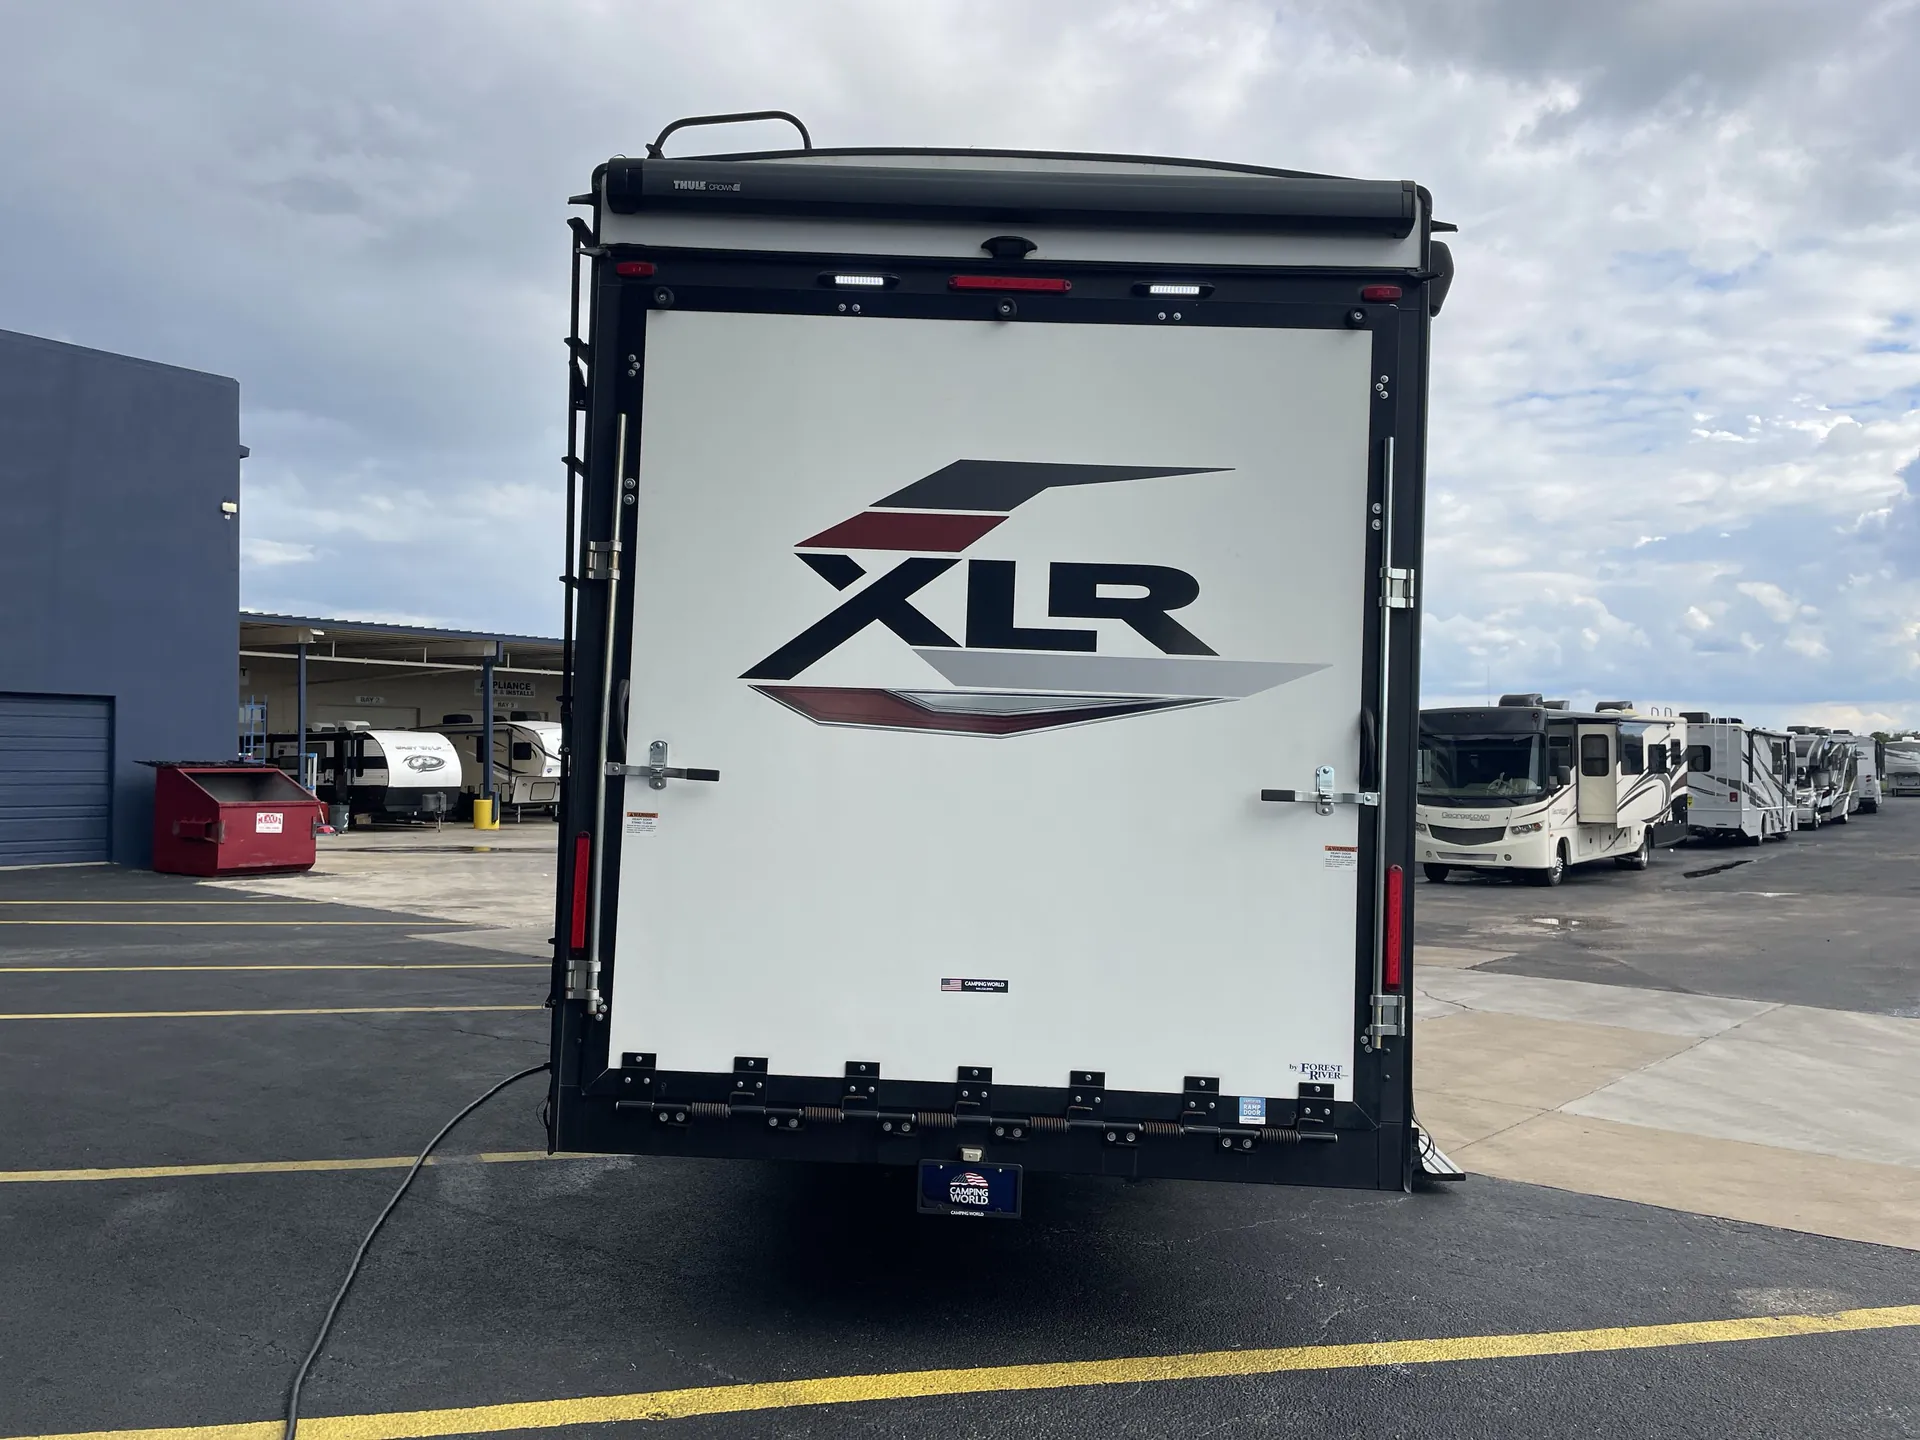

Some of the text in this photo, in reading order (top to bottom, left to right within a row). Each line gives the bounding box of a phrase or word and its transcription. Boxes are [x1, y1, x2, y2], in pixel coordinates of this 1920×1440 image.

[673, 180, 706, 190] THULE
[737, 553, 1220, 681] XLR
[480, 680, 531, 690] APLIANCE
[1289, 1062, 1342, 1073] by FOREST
[1310, 1071, 1341, 1080] RIVER
[949, 1186, 989, 1197] CAMPING
[949, 1194, 989, 1206] WORLD
